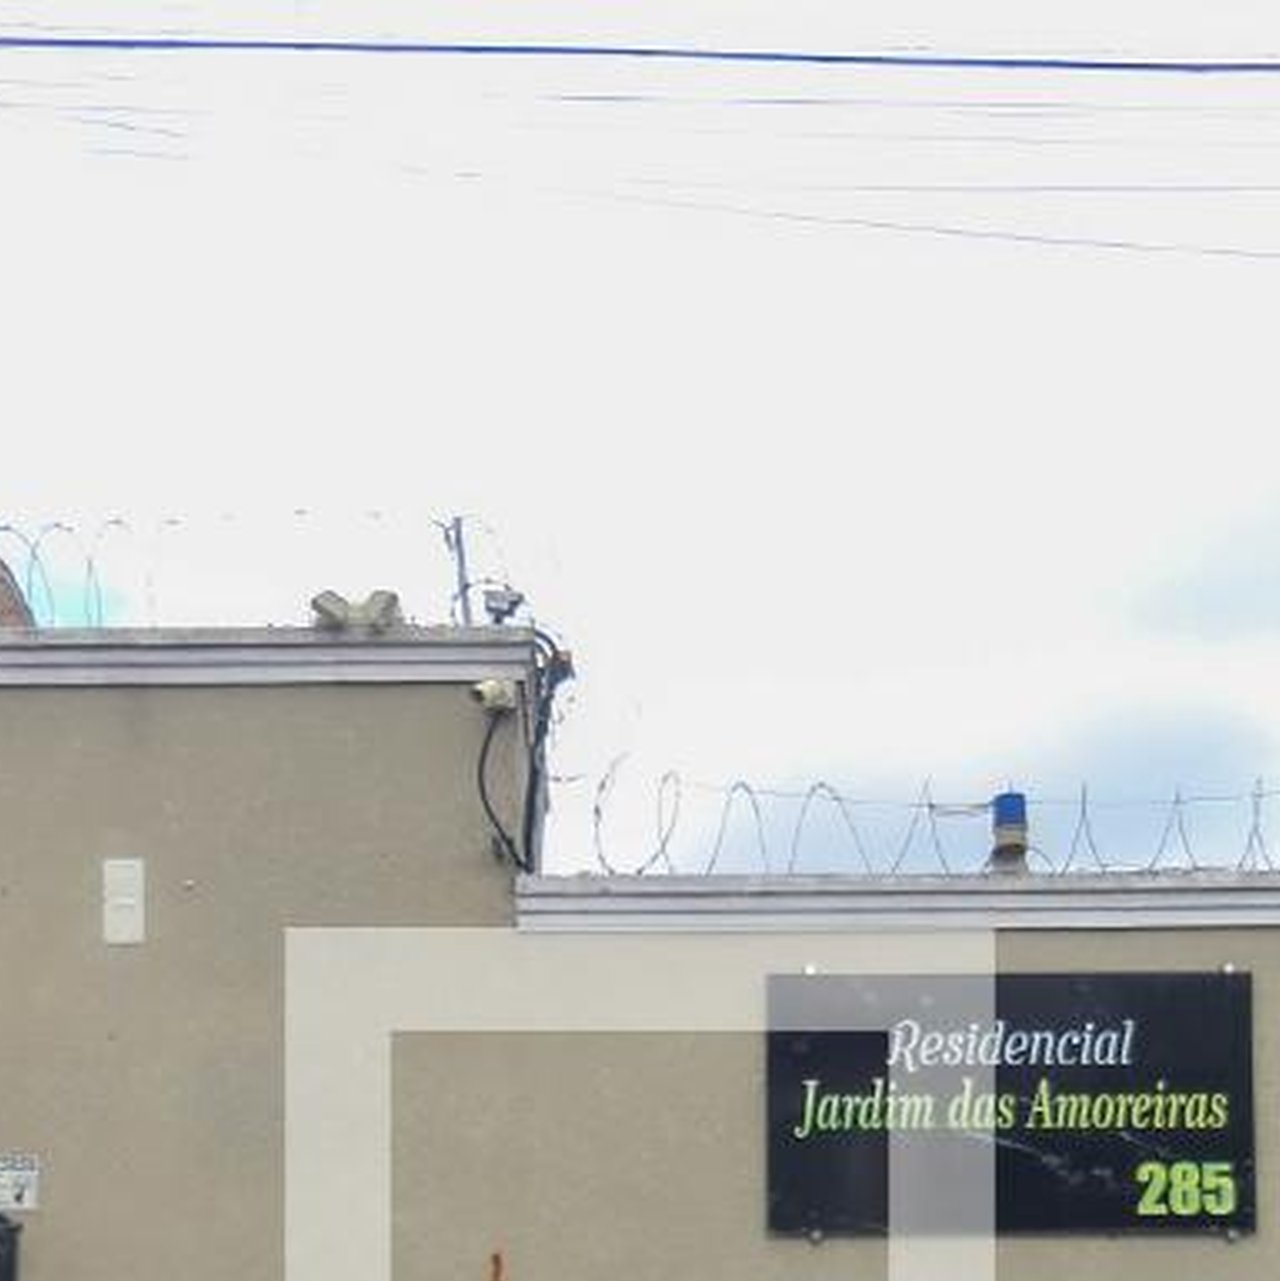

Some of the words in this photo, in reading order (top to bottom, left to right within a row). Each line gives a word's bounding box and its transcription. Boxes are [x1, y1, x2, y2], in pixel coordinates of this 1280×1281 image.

[887, 1018, 1136, 1072] Residencial
[794, 1079, 934, 1138] Jardim
[948, 1078, 1014, 1130] das
[1026, 1077, 1229, 1130] Amoreiras
[1136, 1162, 1236, 1216] 285
